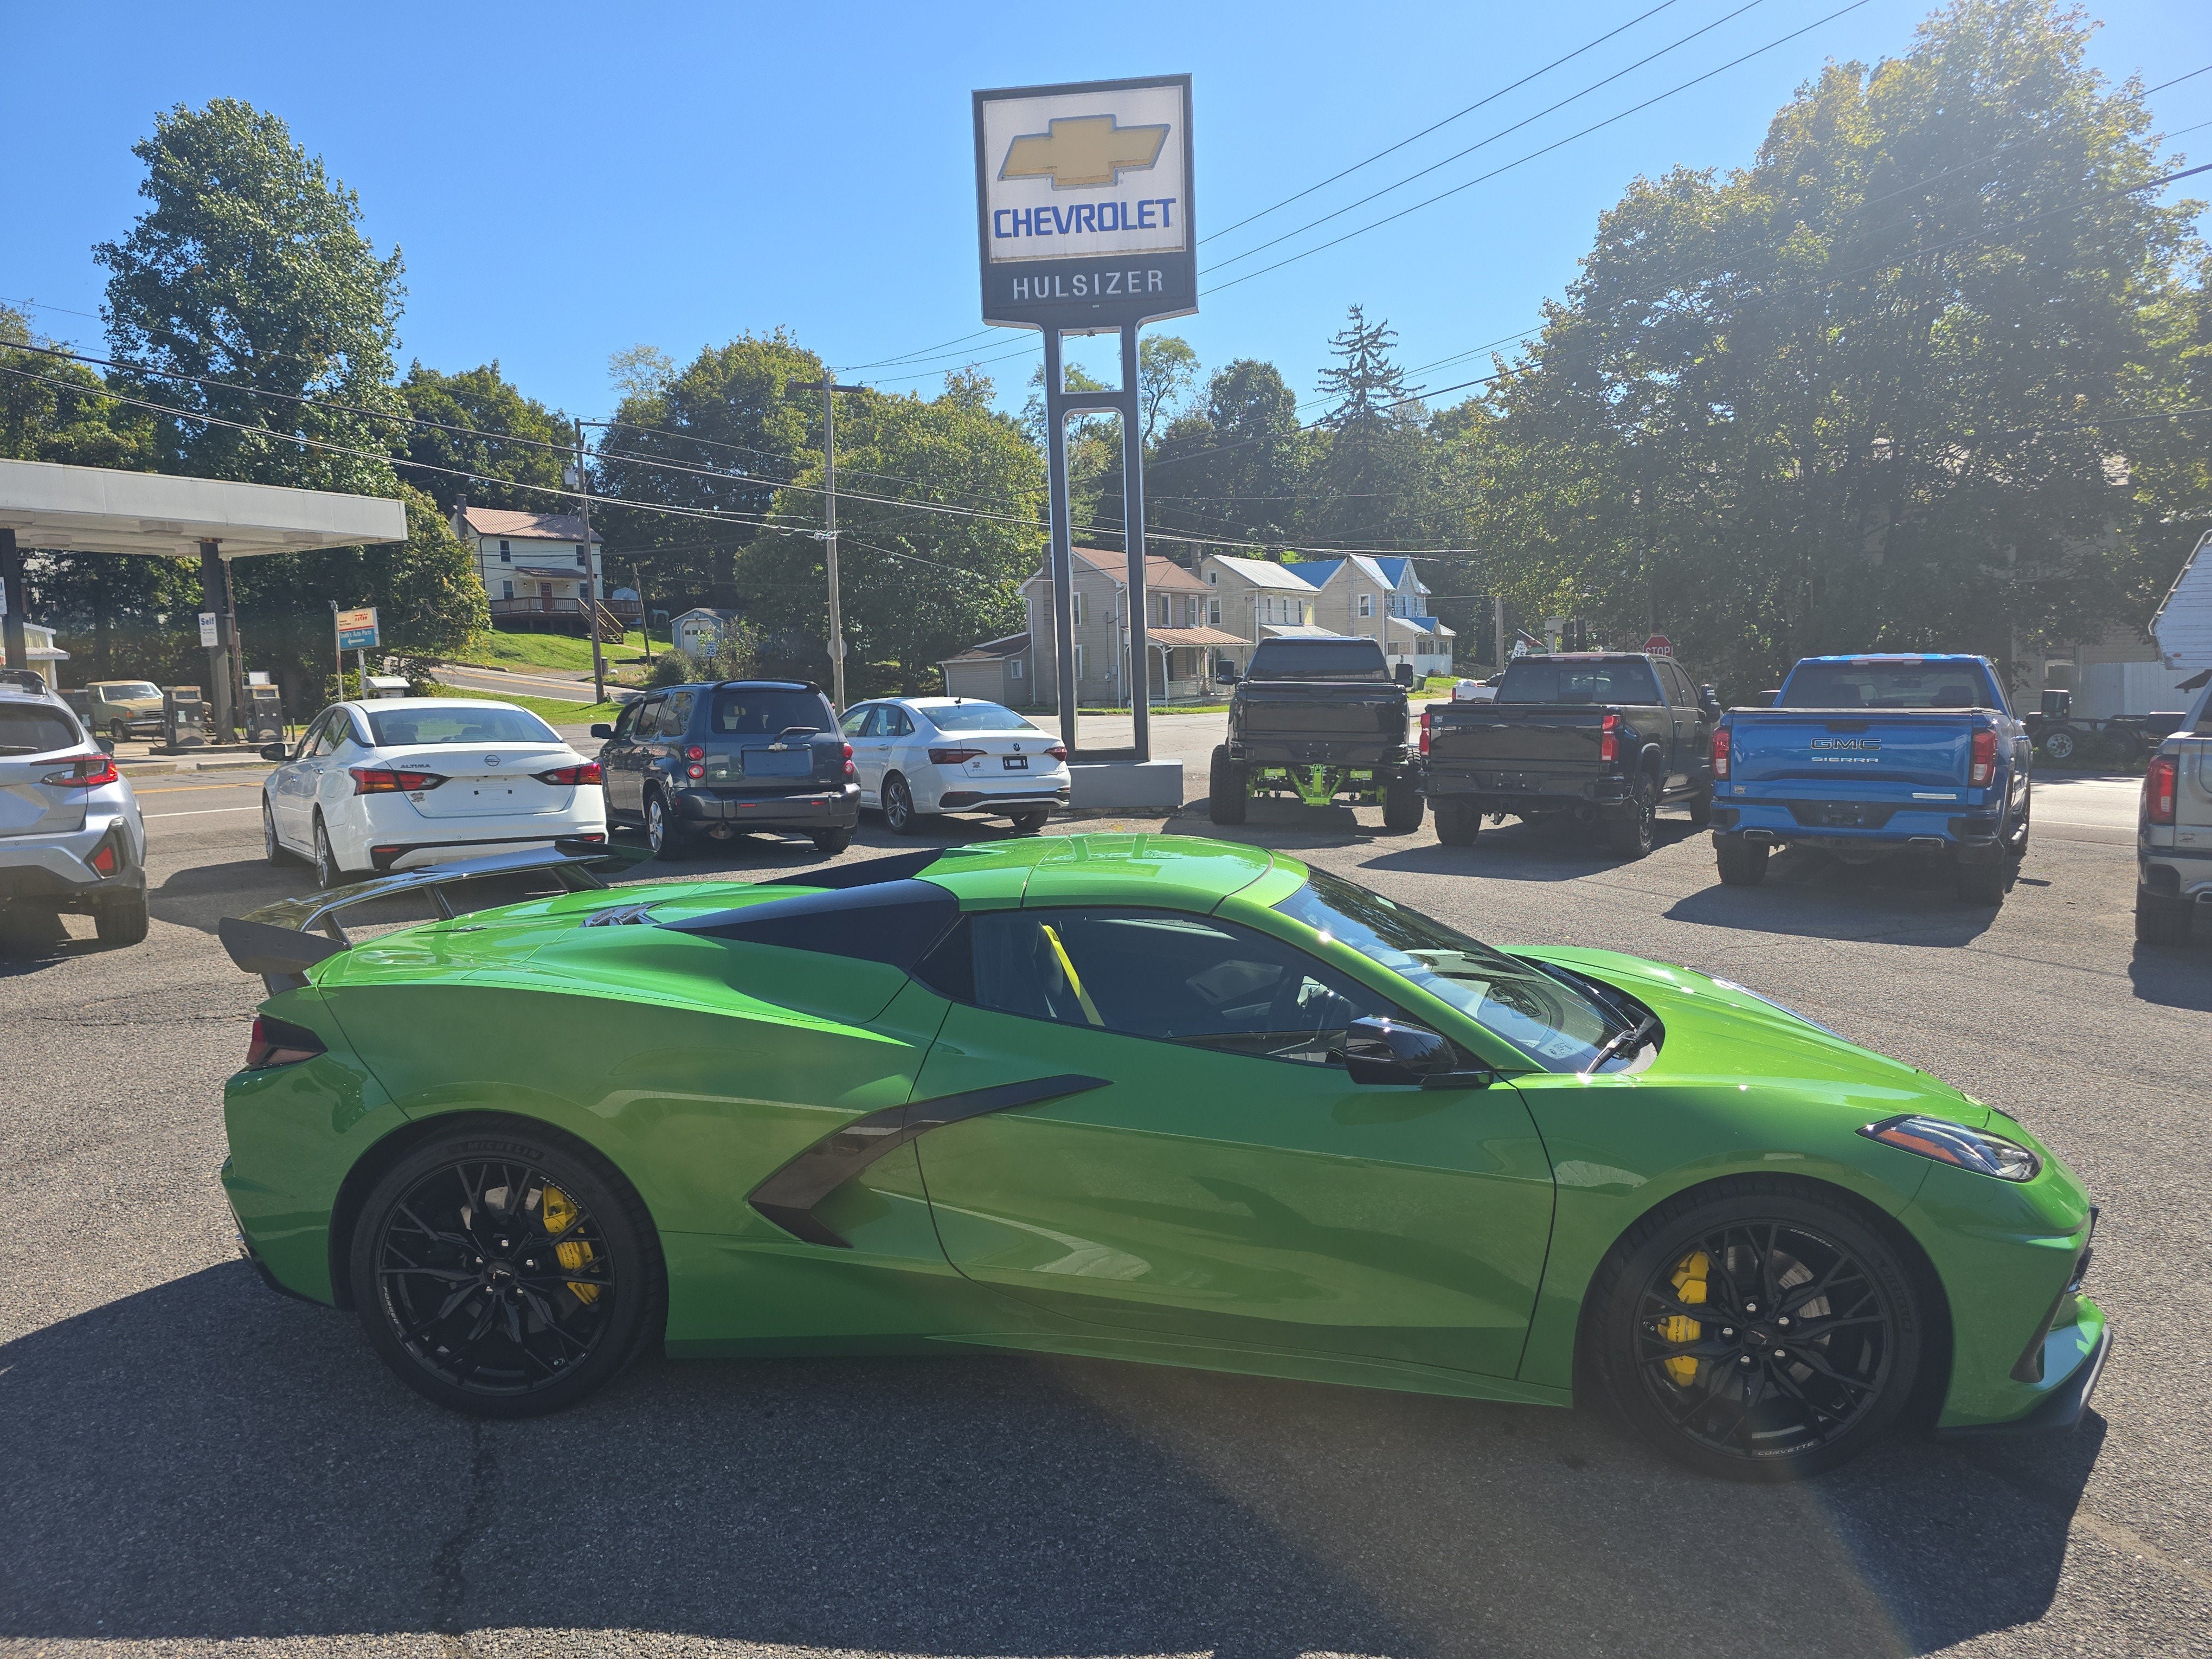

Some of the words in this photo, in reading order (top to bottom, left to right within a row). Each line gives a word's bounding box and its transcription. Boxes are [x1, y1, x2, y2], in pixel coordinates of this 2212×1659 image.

[994, 198, 1176, 238] CHEVROLET
[1013, 270, 1163, 300] HULSIZER
[201, 617, 214, 626] Self
[1645, 646, 1670, 655] STOP
[1810, 738, 1881, 750] GMC
[468, 1140, 540, 1159] MICHELIN
[539, 1175, 583, 1210] CORVETTE
[1790, 1228, 1833, 1247] FORGED
[382, 1286, 399, 1324] FORGED
[1758, 1441, 1815, 1456] CORVETTE
